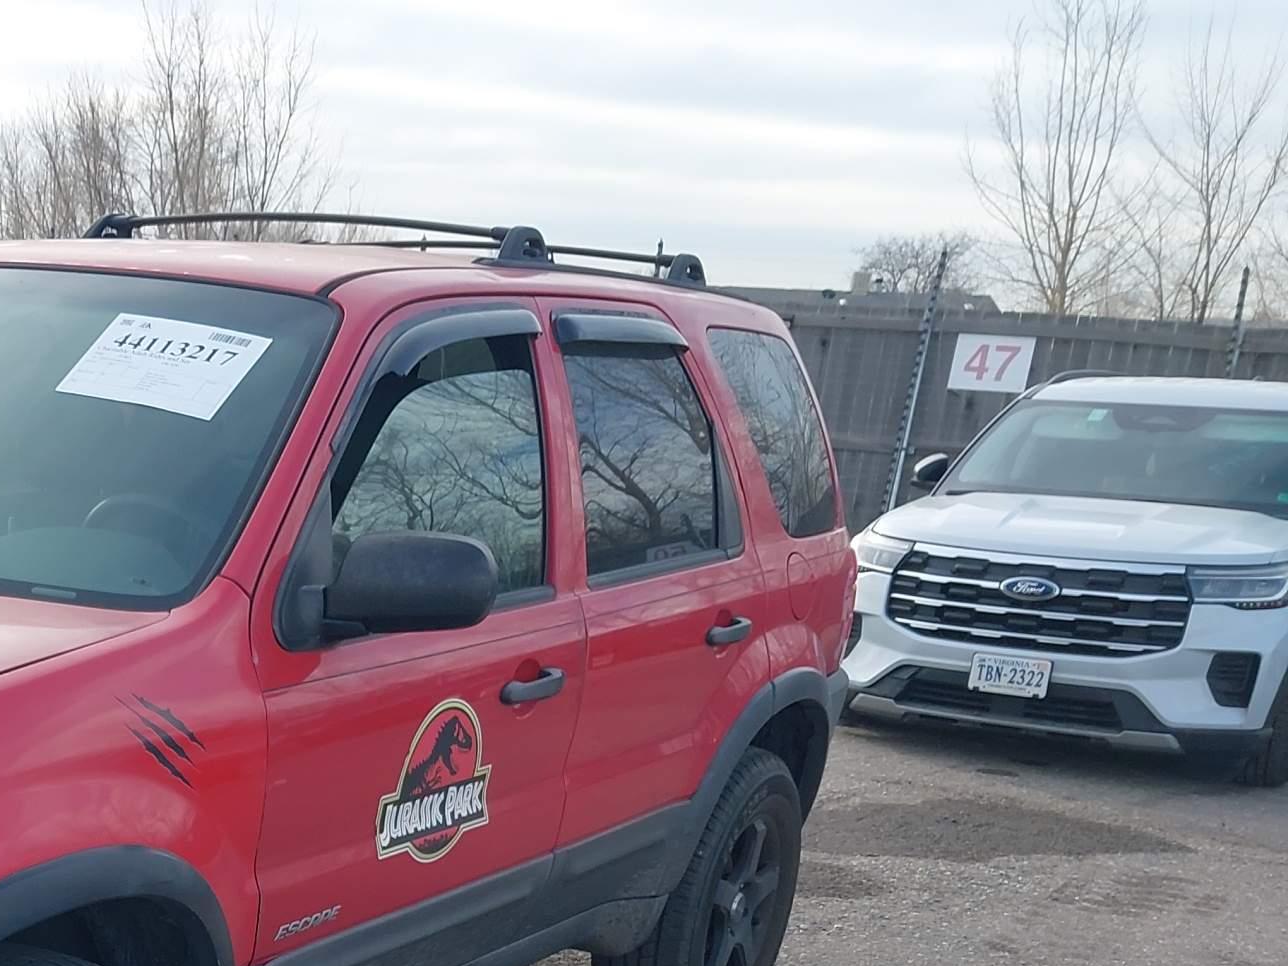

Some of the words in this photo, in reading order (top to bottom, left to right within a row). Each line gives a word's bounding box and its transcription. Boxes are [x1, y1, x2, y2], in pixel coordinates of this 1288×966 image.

[114, 332, 240, 367] 44113217
[963, 343, 1022, 382] 47
[977, 663, 1045, 689] TBN-2322
[993, 657, 1030, 670] VIRGINIA
[444, 780, 484, 827] PARK
